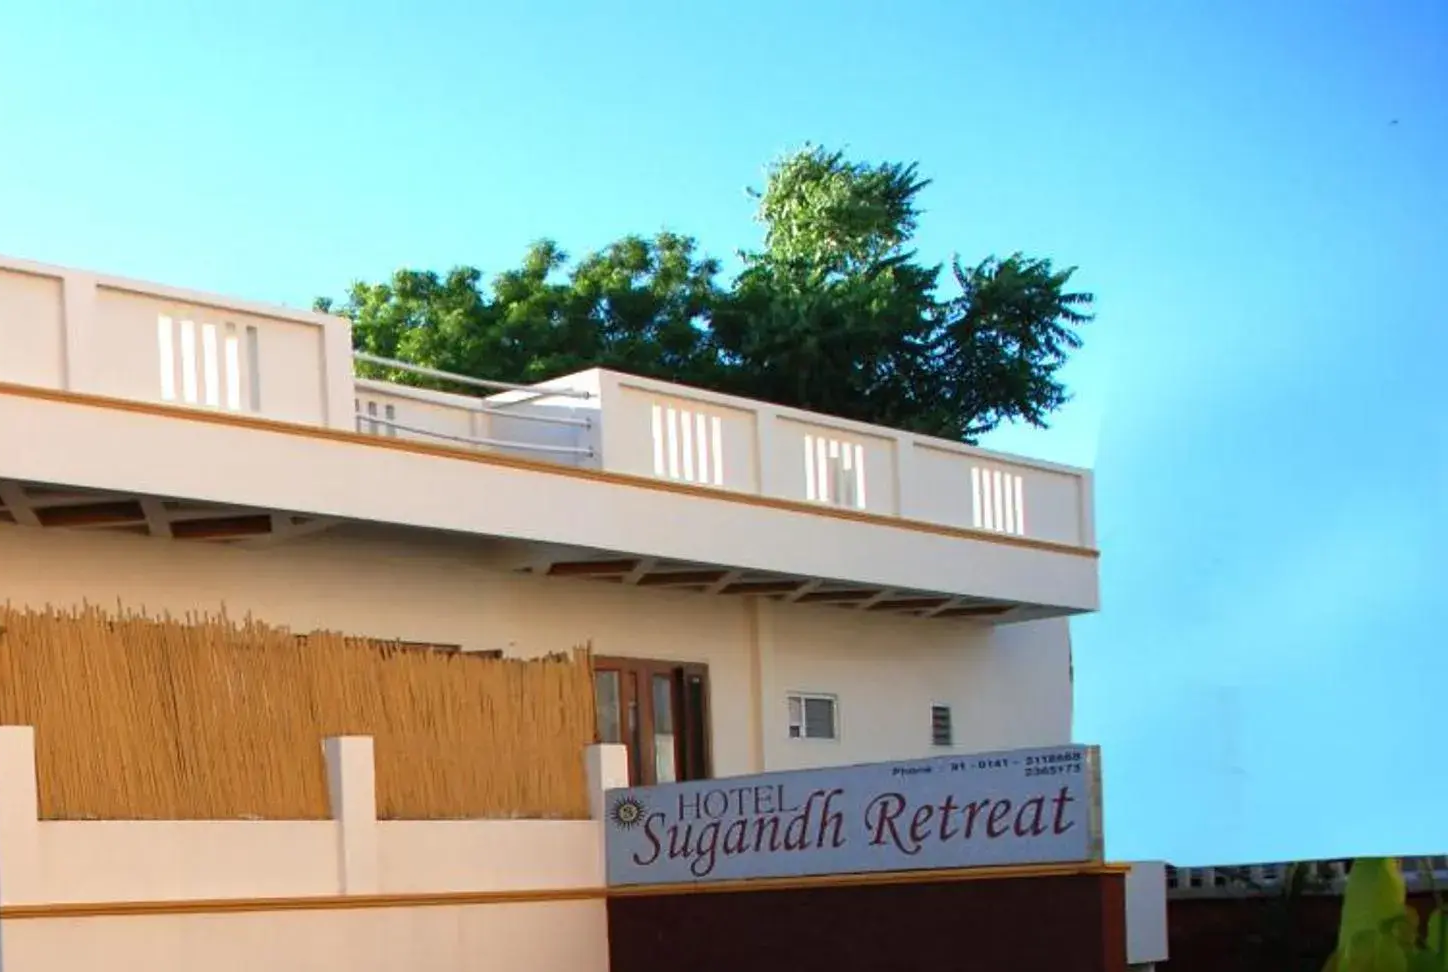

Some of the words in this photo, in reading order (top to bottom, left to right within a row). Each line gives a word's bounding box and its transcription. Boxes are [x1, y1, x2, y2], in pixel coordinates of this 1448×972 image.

[633, 788, 847, 877] Sugandh
[865, 786, 1076, 856] Retreat
[678, 784, 801, 821] HOTEL
